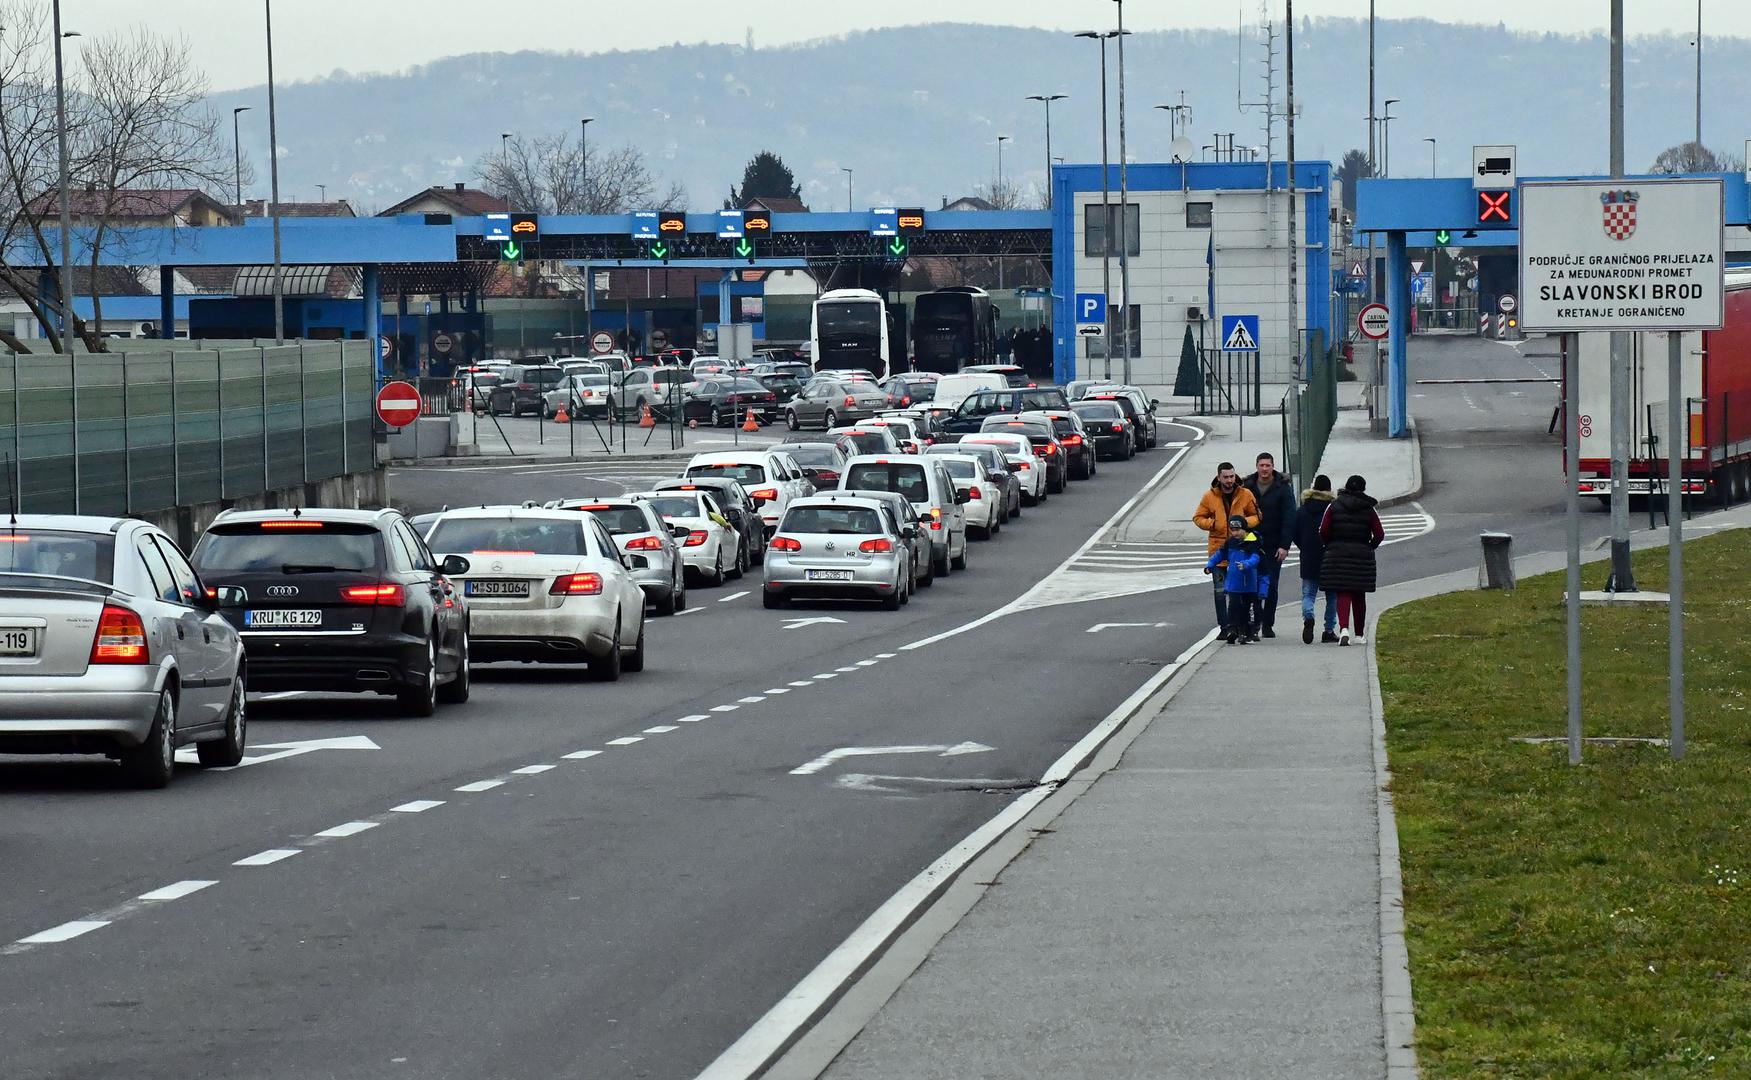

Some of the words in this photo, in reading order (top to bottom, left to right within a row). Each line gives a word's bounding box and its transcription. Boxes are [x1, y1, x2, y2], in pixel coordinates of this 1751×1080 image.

[1529, 253, 1585, 266] PODRUČJE
[1589, 253, 1650, 265] GRANIČNOG
[1653, 253, 1714, 264] PRIJELAZA
[1550, 269, 1565, 280] ZA
[1568, 268, 1645, 279] MEĐUNARODNI
[1648, 267, 1693, 278] PROMET
[1540, 284, 1646, 301] SLAVONSKI
[1652, 283, 1703, 300] BROD
[1084, 298, 1098, 318] P
[1557, 307, 1614, 318] KRETANJE
[1618, 305, 1685, 317] OGRANIČENO
[471, 583, 479, 593] M
[485, 583, 499, 593] SD
[502, 583, 528, 593] 1064
[252, 611, 274, 624] KRU
[282, 611, 297, 624] KG
[300, 611, 321, 624] 129
